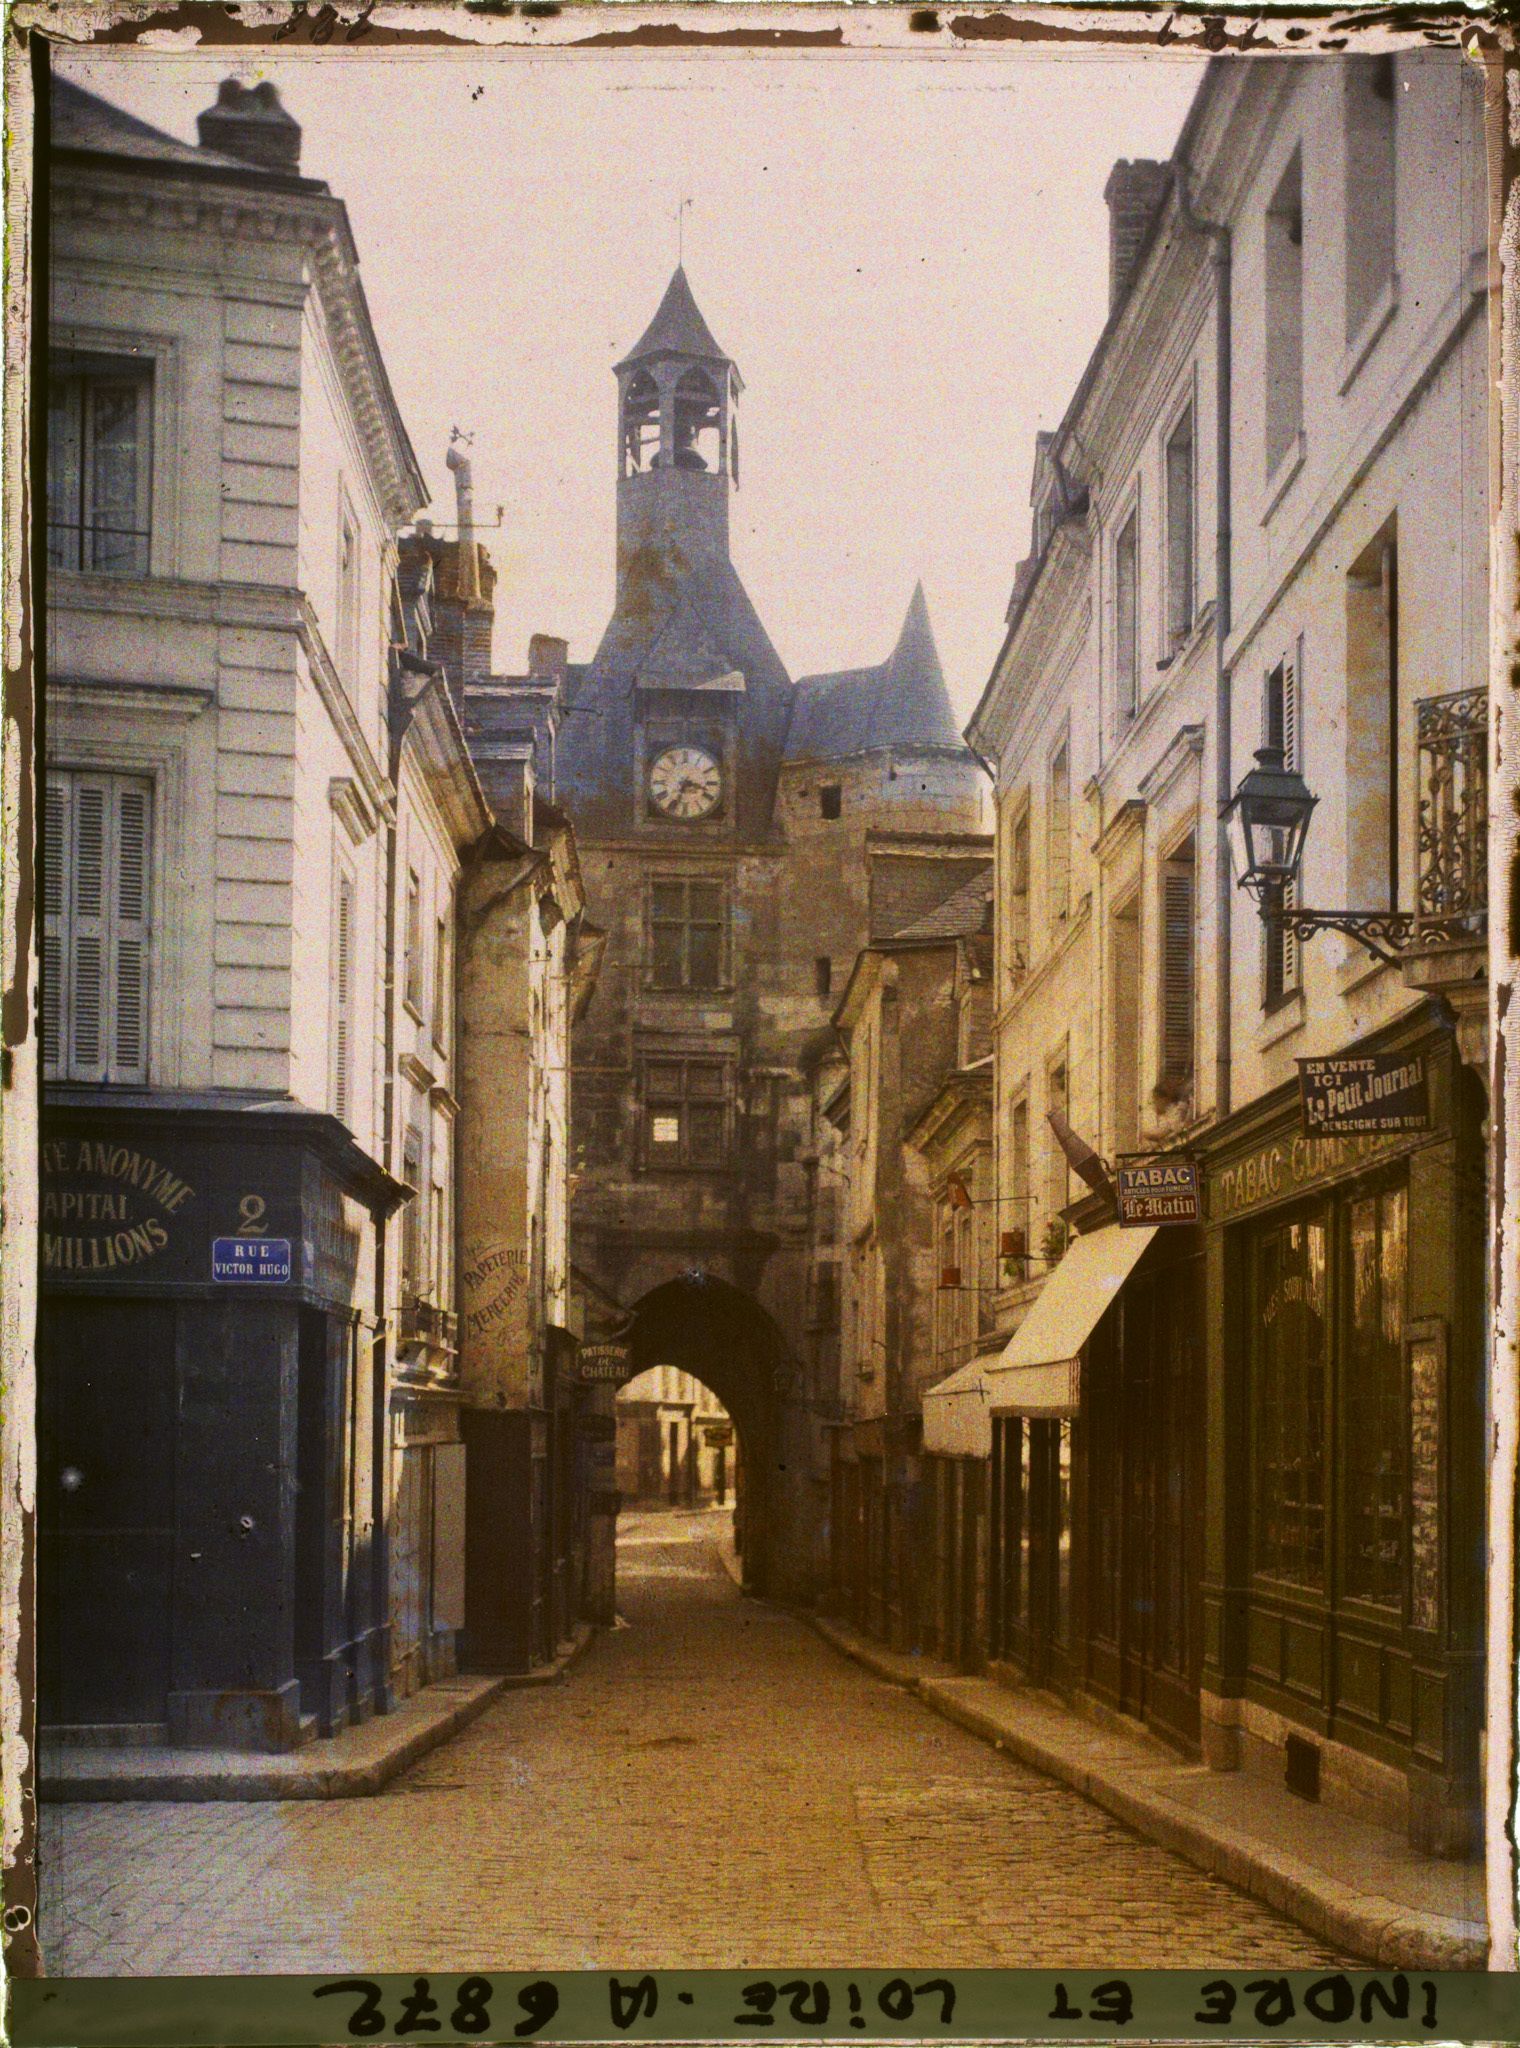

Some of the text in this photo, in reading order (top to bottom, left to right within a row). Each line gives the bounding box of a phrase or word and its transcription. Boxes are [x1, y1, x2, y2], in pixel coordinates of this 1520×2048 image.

[1306, 1059, 1376, 1074] EN VENTE
[1307, 1056, 1423, 1126] Le Petit Journal
[1313, 1074, 1342, 1087] ICI
[1321, 1115, 1427, 1132] RENSEIGNE SUR TOUT
[77, 1140, 196, 1214] ANONYME
[1124, 1167, 1190, 1188] TABAC
[1220, 1147, 1281, 1211] TABAC
[236, 1193, 269, 1236] 2
[1122, 1196, 1195, 1220] Le Matin
[43, 1217, 169, 1269] MILLIONS
[234, 1244, 270, 1258] RUE
[215, 1262, 288, 1276] VICTOR HUGO
[463, 1248, 528, 1292] PAPETERIE
